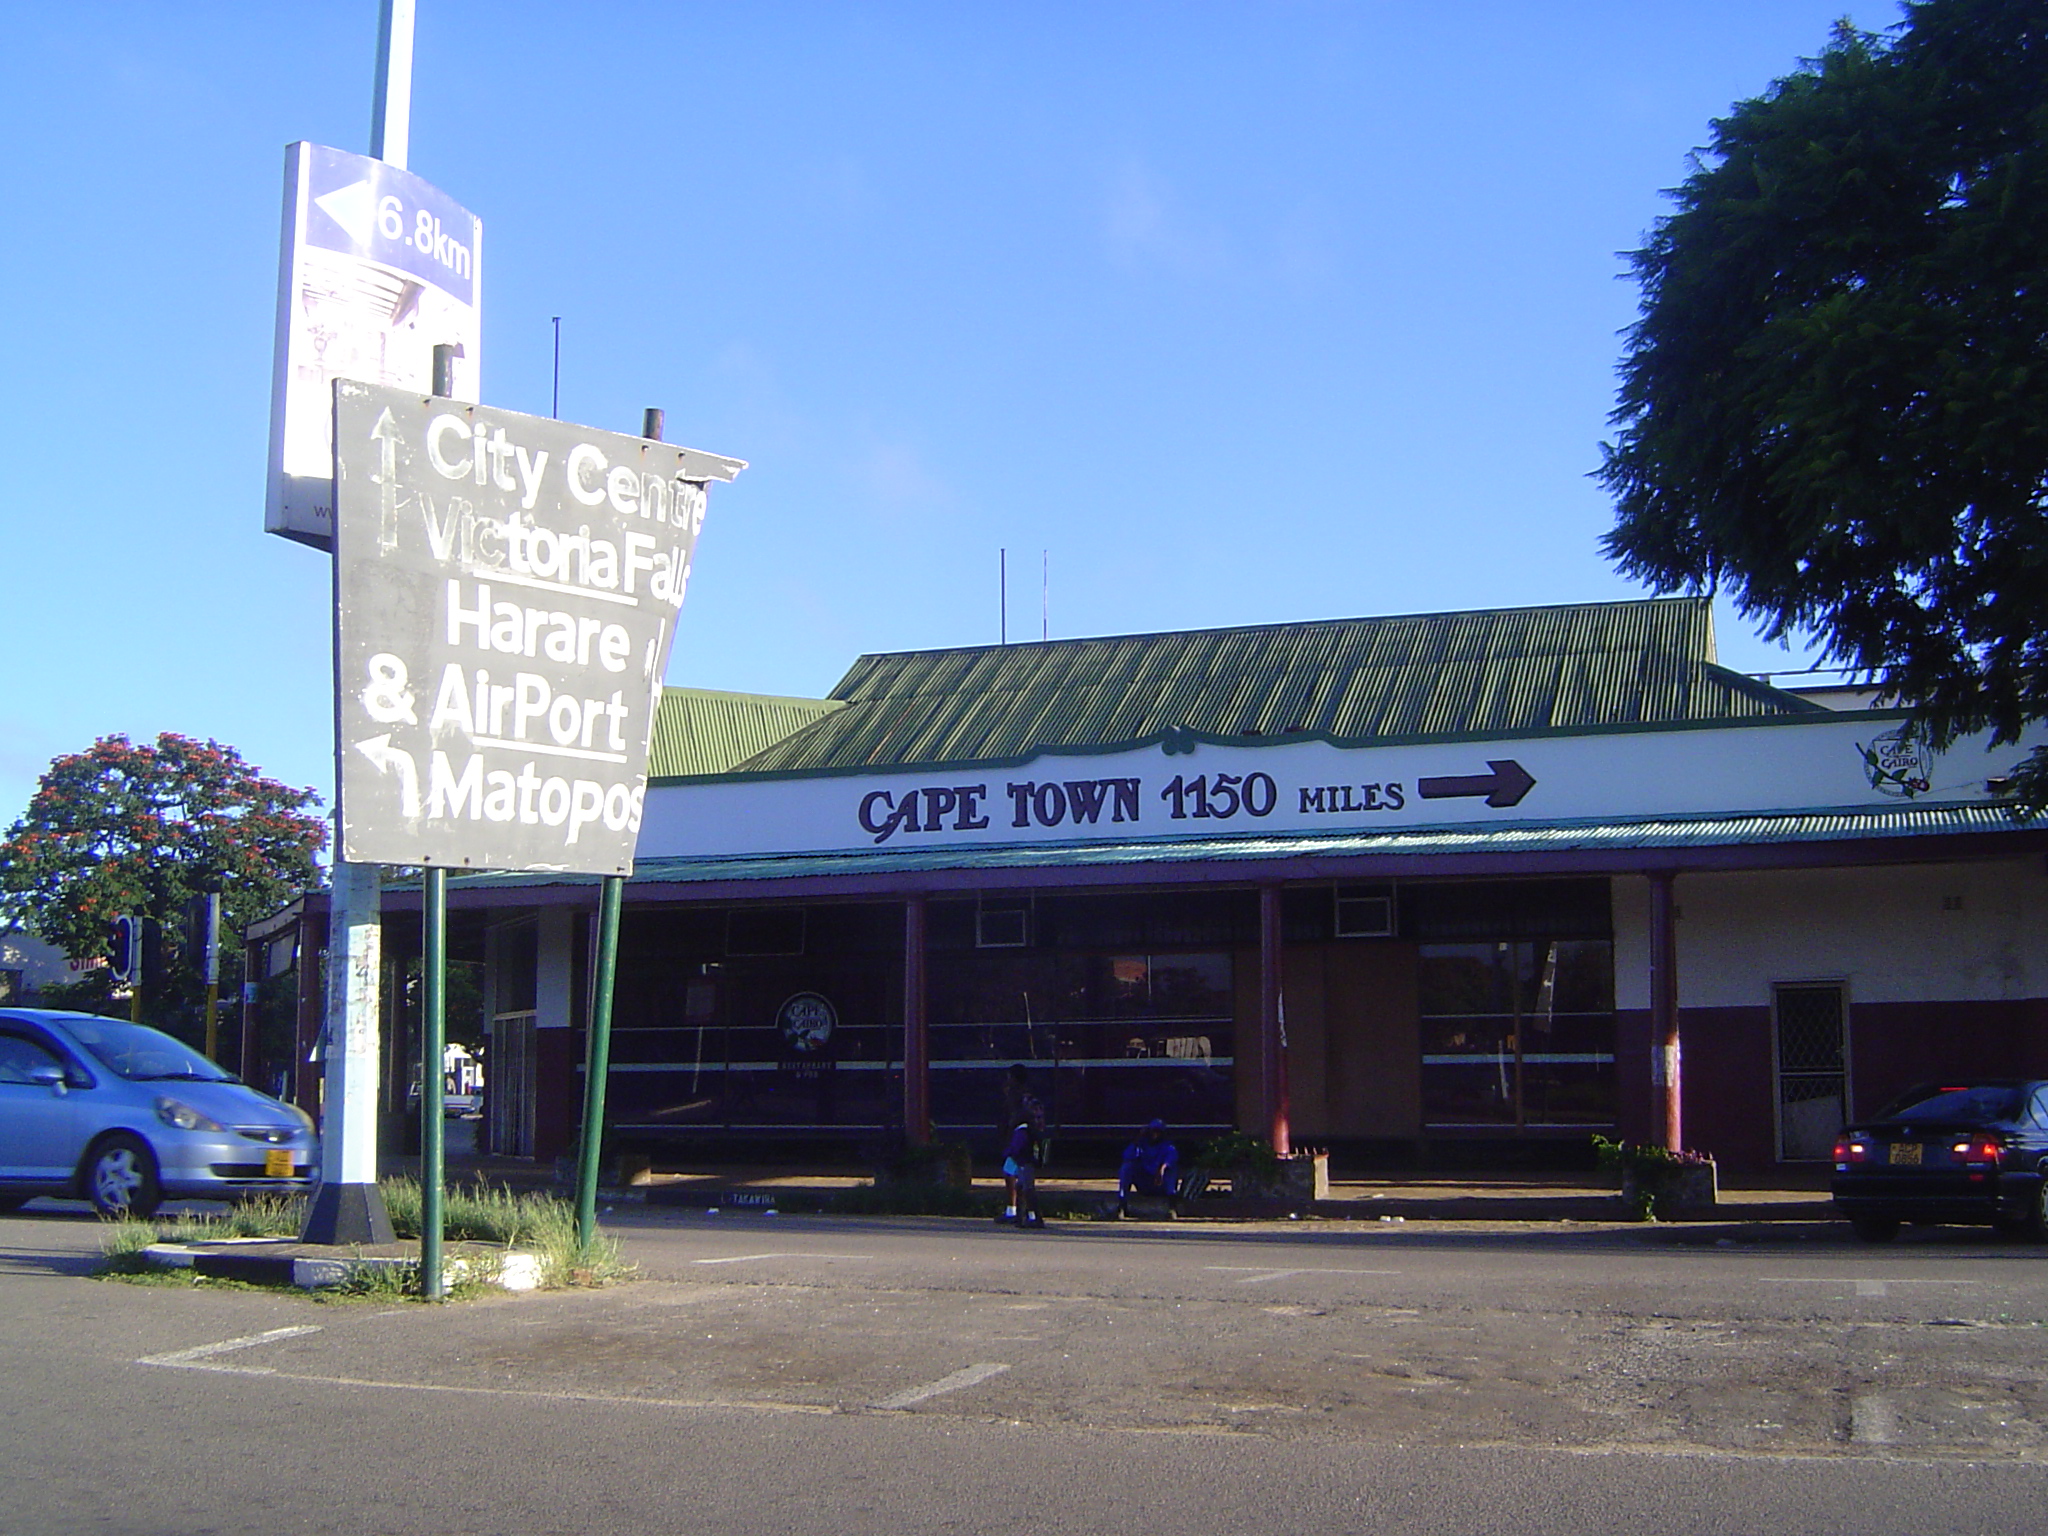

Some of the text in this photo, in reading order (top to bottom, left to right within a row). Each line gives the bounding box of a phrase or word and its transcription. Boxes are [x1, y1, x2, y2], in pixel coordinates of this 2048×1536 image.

[378, 195, 471, 280] 6.8km
[427, 414, 707, 536] City Centre
[418, 491, 619, 589] Victoria
[447, 578, 630, 672] Harare
[363, 653, 629, 750] & AirPort
[428, 750, 646, 846] Matopos
[858, 772, 1405, 844] CAPE TOWN 1150 MILES
[1881, 757, 1918, 769] CAIRO
